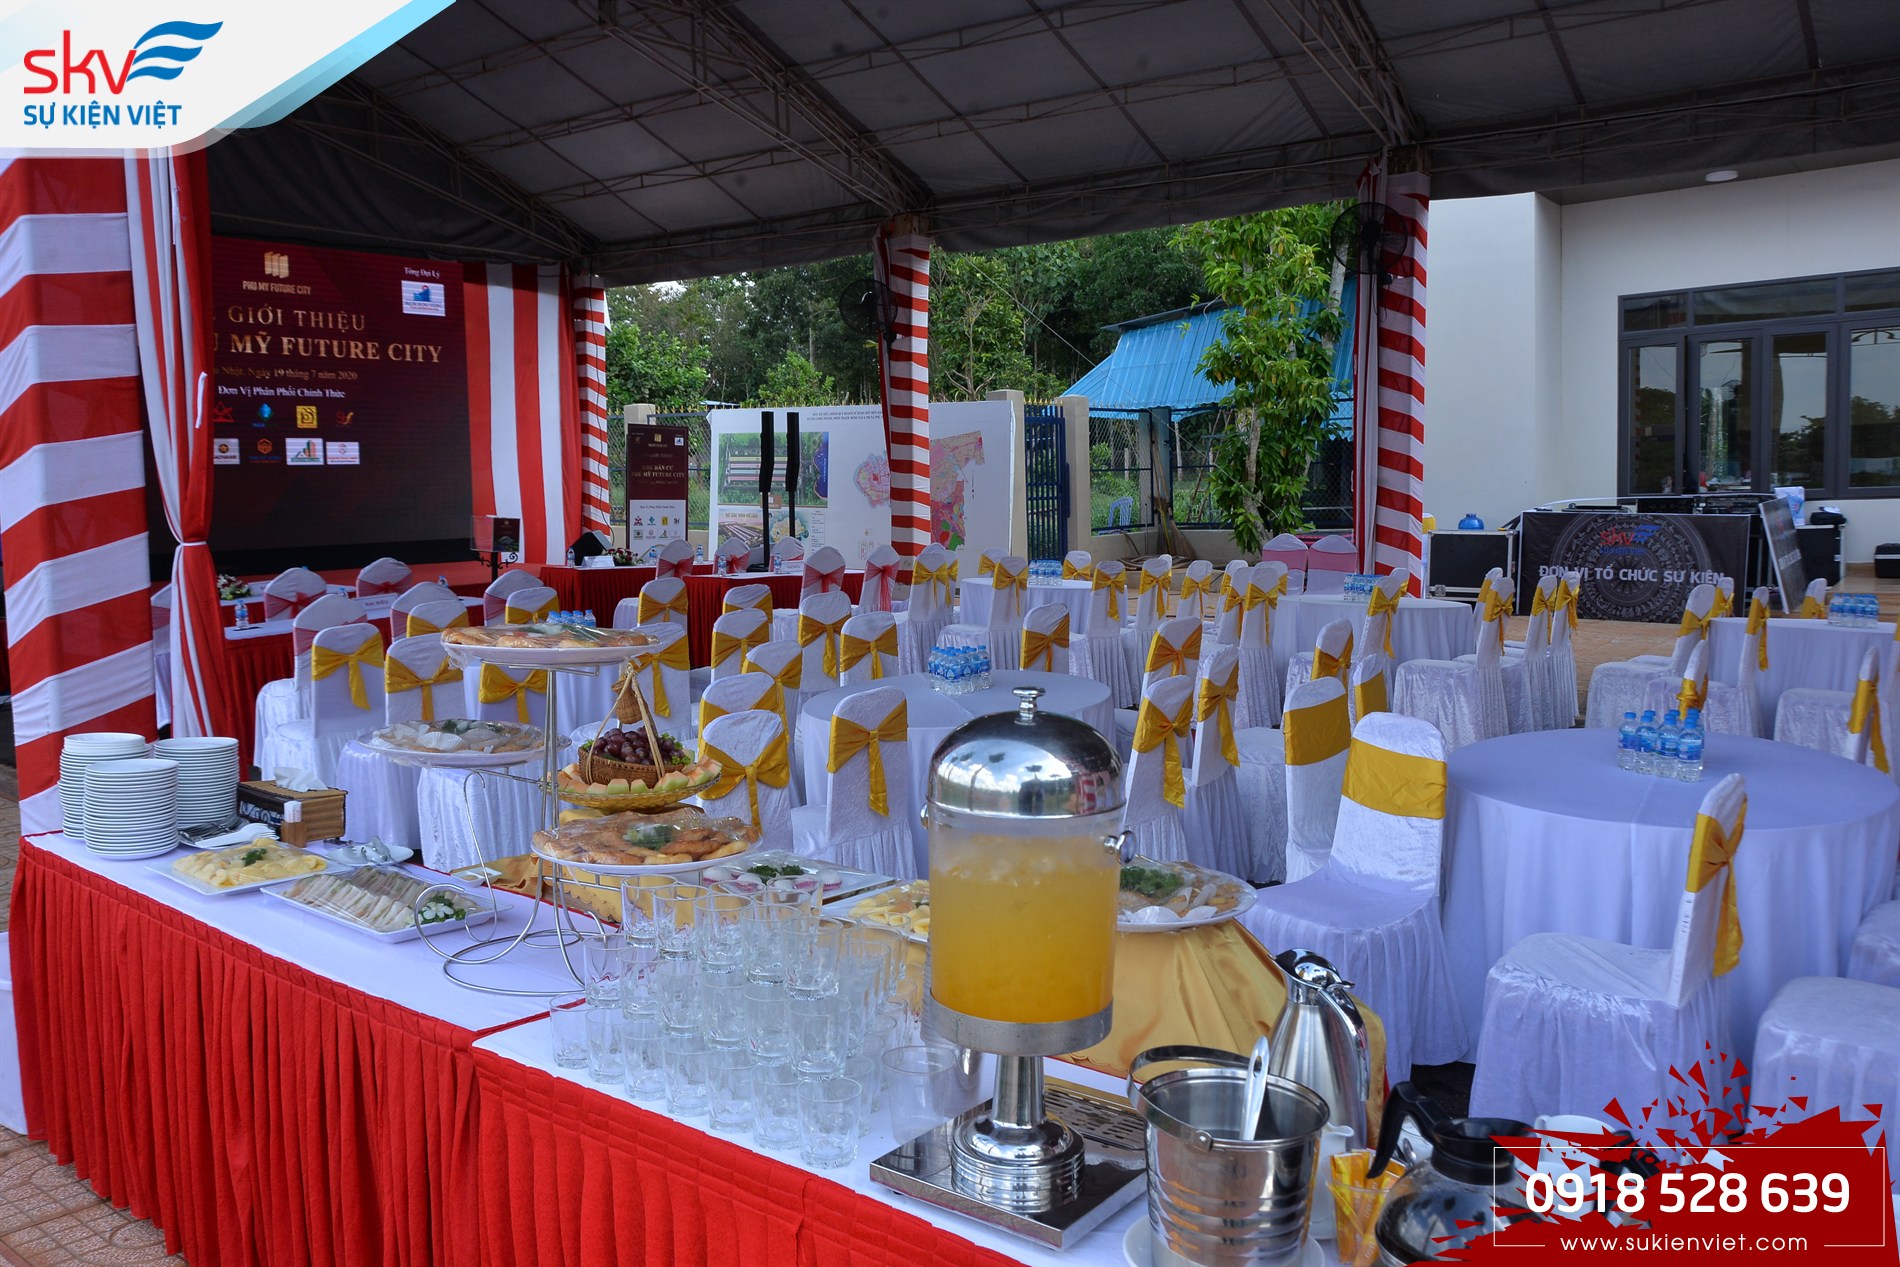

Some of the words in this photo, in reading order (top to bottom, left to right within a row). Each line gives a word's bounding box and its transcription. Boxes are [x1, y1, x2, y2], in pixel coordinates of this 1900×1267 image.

[270, 283, 296, 294] FUTURE
[297, 285, 311, 295] CITY
[228, 303, 283, 326] GIỚI
[293, 309, 366, 333] THIỆU
[230, 331, 271, 354] MỸ
[281, 336, 381, 360] FUTURE
[388, 342, 442, 363] CITY
[273, 368, 285, 377] 19
[1594, 563, 1614, 580] TỔ
[1619, 565, 1657, 582] CHỨC
[1663, 569, 1687, 586] SỰ
